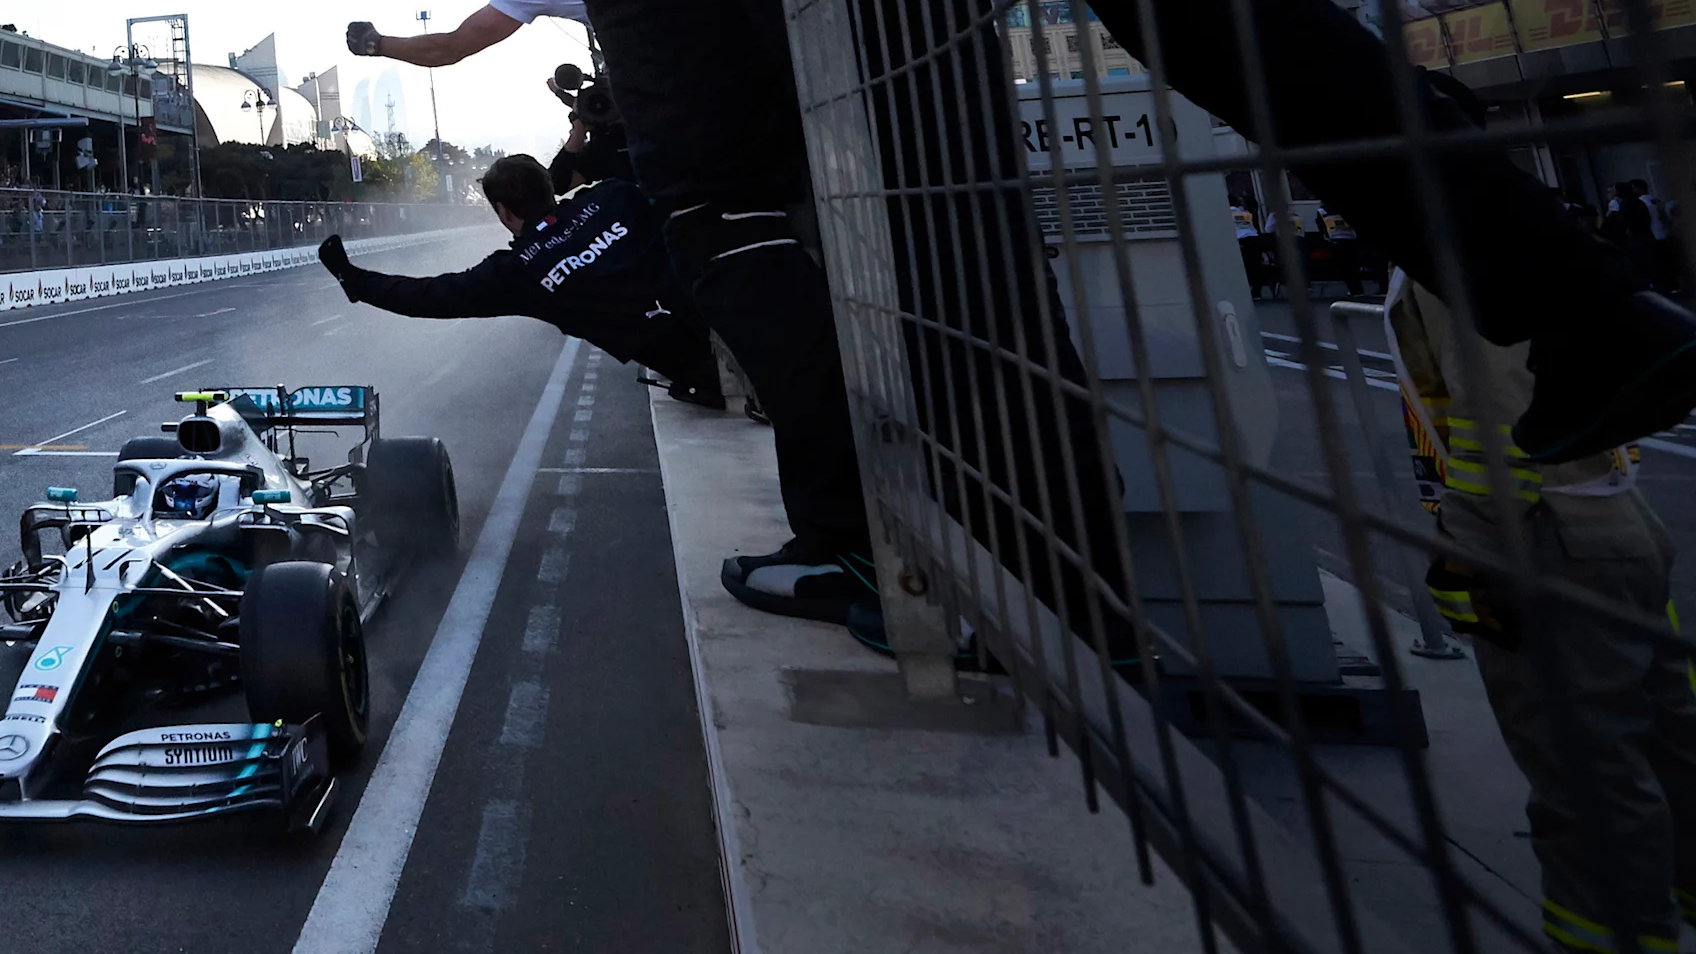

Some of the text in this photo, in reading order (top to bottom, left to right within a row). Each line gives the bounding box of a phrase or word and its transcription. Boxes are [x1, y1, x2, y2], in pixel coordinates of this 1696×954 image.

[1020, 113, 1178, 153] RE-RT-1
[519, 202, 601, 265] Meredes-AMG
[540, 221, 629, 293] PETRONAS
[15, 289, 35, 302] SOCAR
[43, 286, 62, 299] SOCAR
[69, 283, 86, 296] SOCAR
[94, 280, 110, 292] SOCAR
[160, 731, 231, 742] PETRONAS
